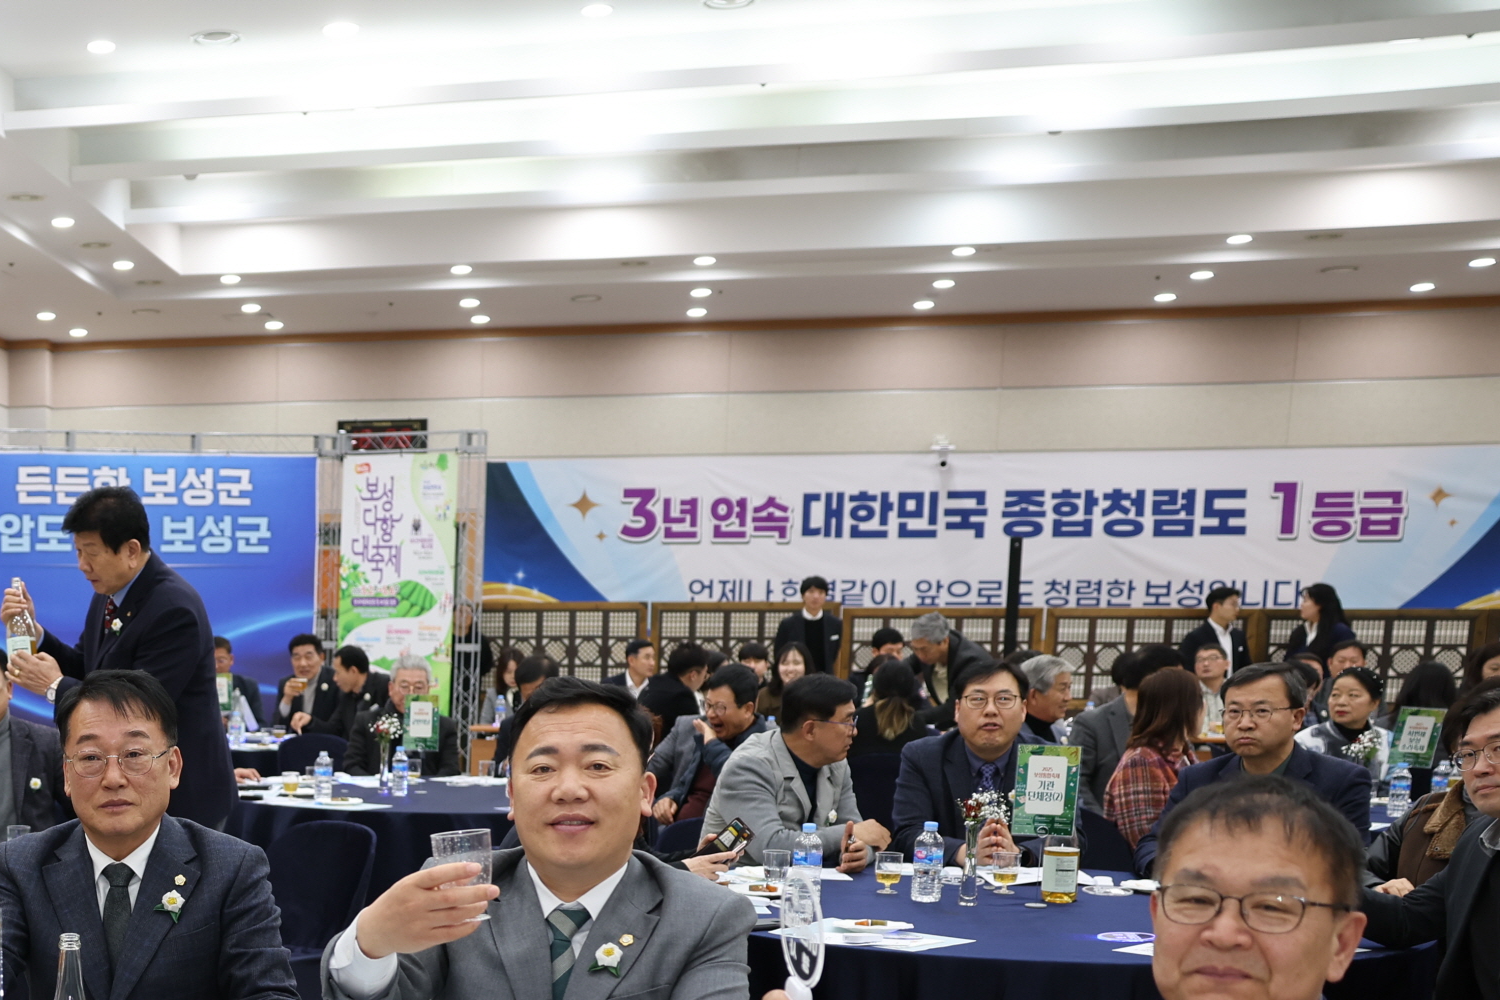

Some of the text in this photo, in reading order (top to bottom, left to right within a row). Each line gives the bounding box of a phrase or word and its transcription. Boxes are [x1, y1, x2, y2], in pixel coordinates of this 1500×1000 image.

[142, 467, 253, 506] 보성군
[619, 487, 699, 541] 3년
[710, 496, 791, 541] 연속
[801, 490, 988, 539] 대한민국
[1001, 487, 1248, 539] 종합청렴도
[160, 515, 271, 553] 보성군
[1044, 578, 1137, 608] 청렴한
[1028, 791, 1063, 802] 단체장(2)
[1037, 780, 1055, 791] 기관
